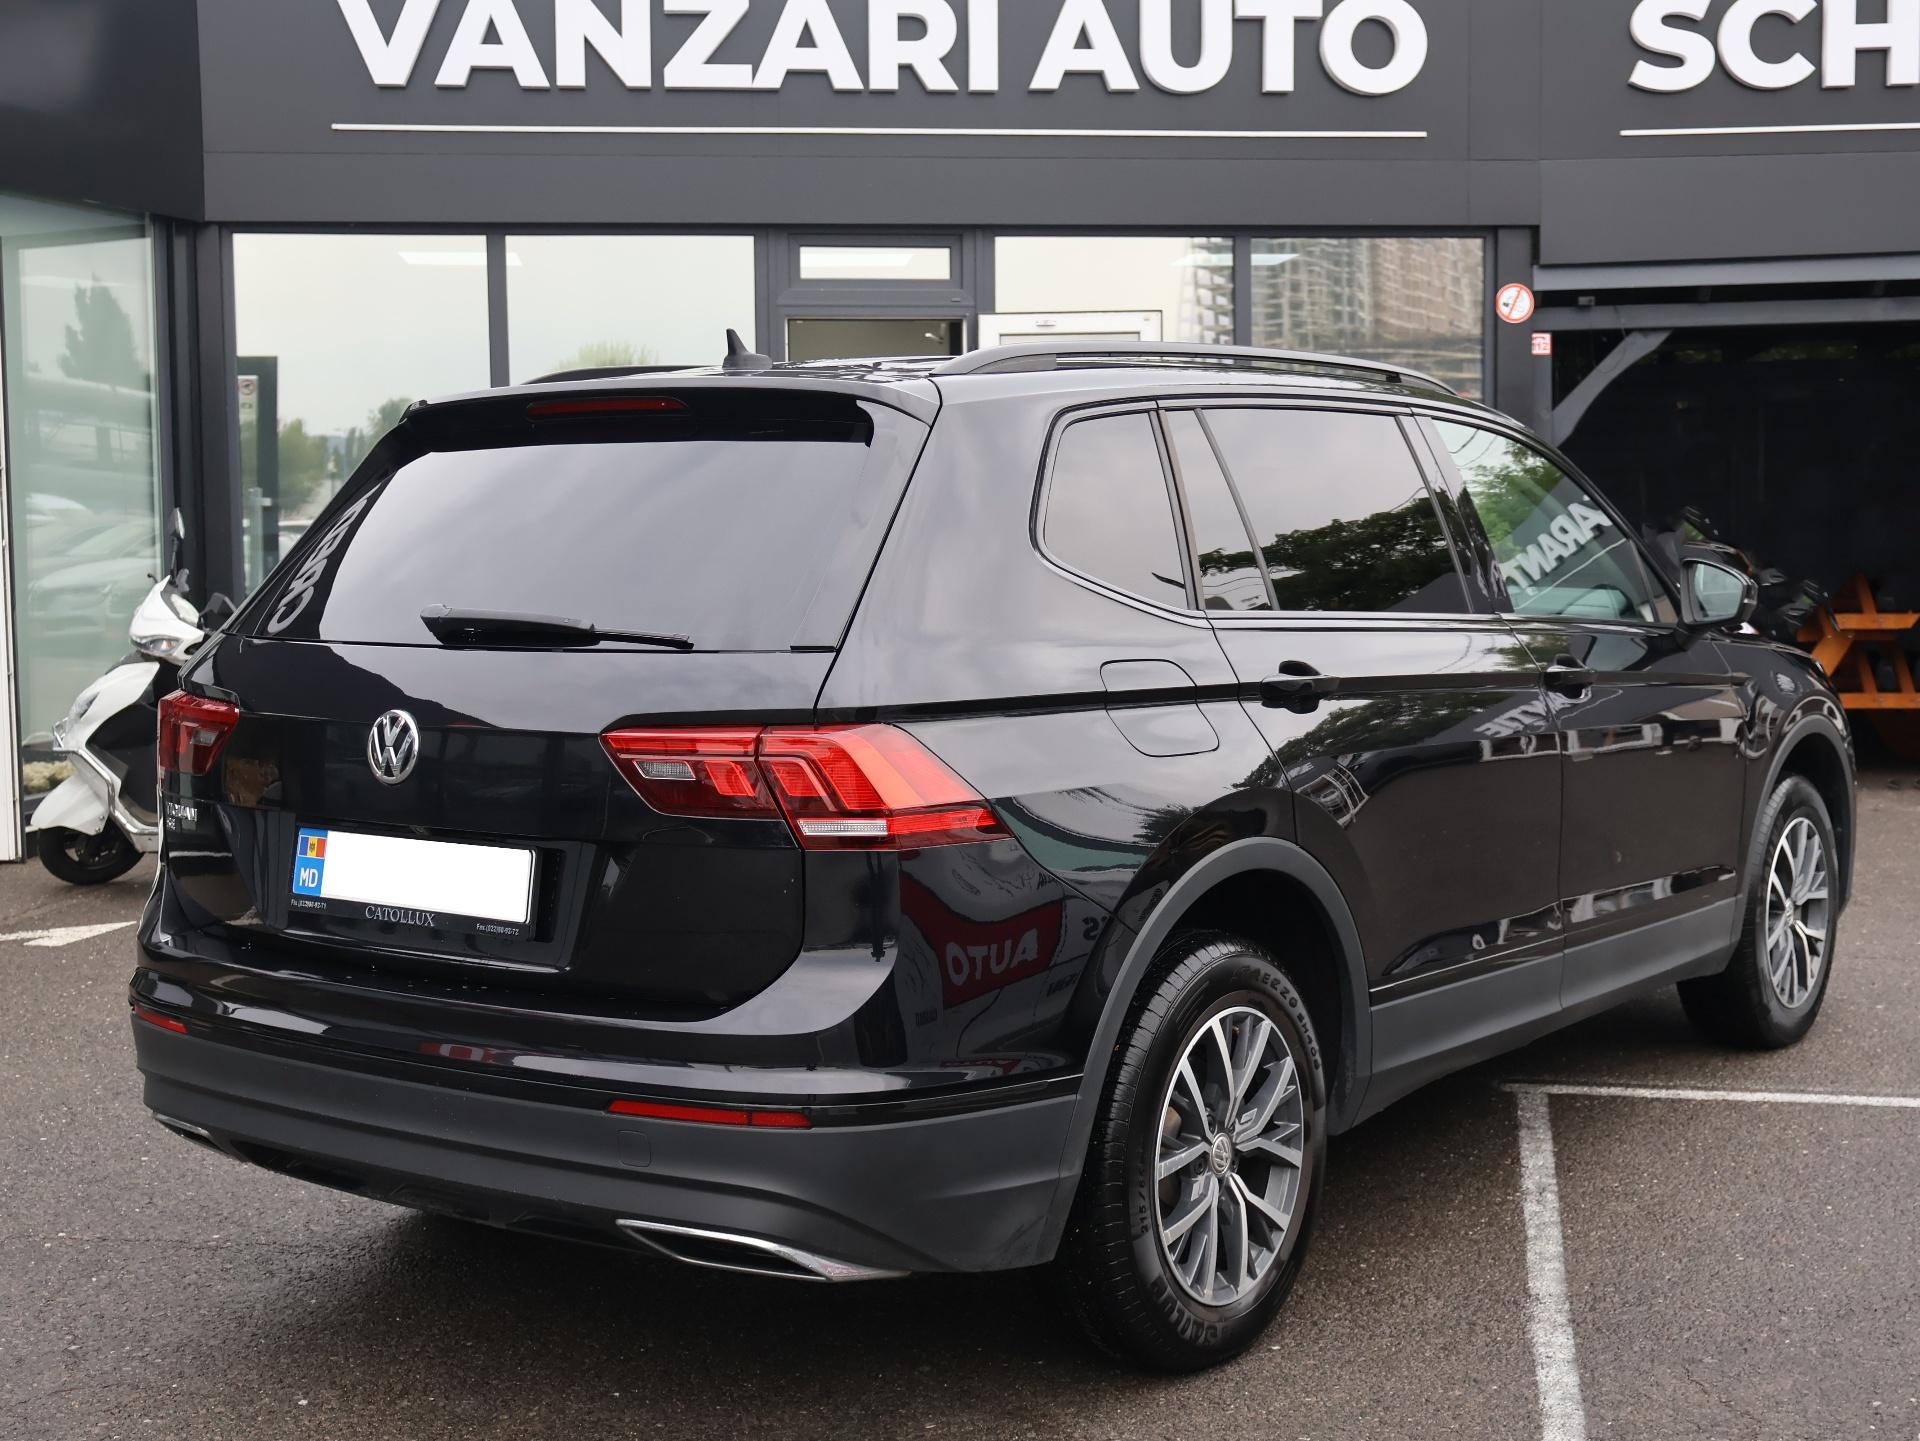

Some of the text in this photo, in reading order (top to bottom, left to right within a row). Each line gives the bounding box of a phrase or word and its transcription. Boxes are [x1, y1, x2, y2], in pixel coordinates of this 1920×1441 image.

[1028, 0, 1428, 95] AUTO
[300, 867, 318, 888] MD
[365, 905, 436, 927] CATOLLUX
